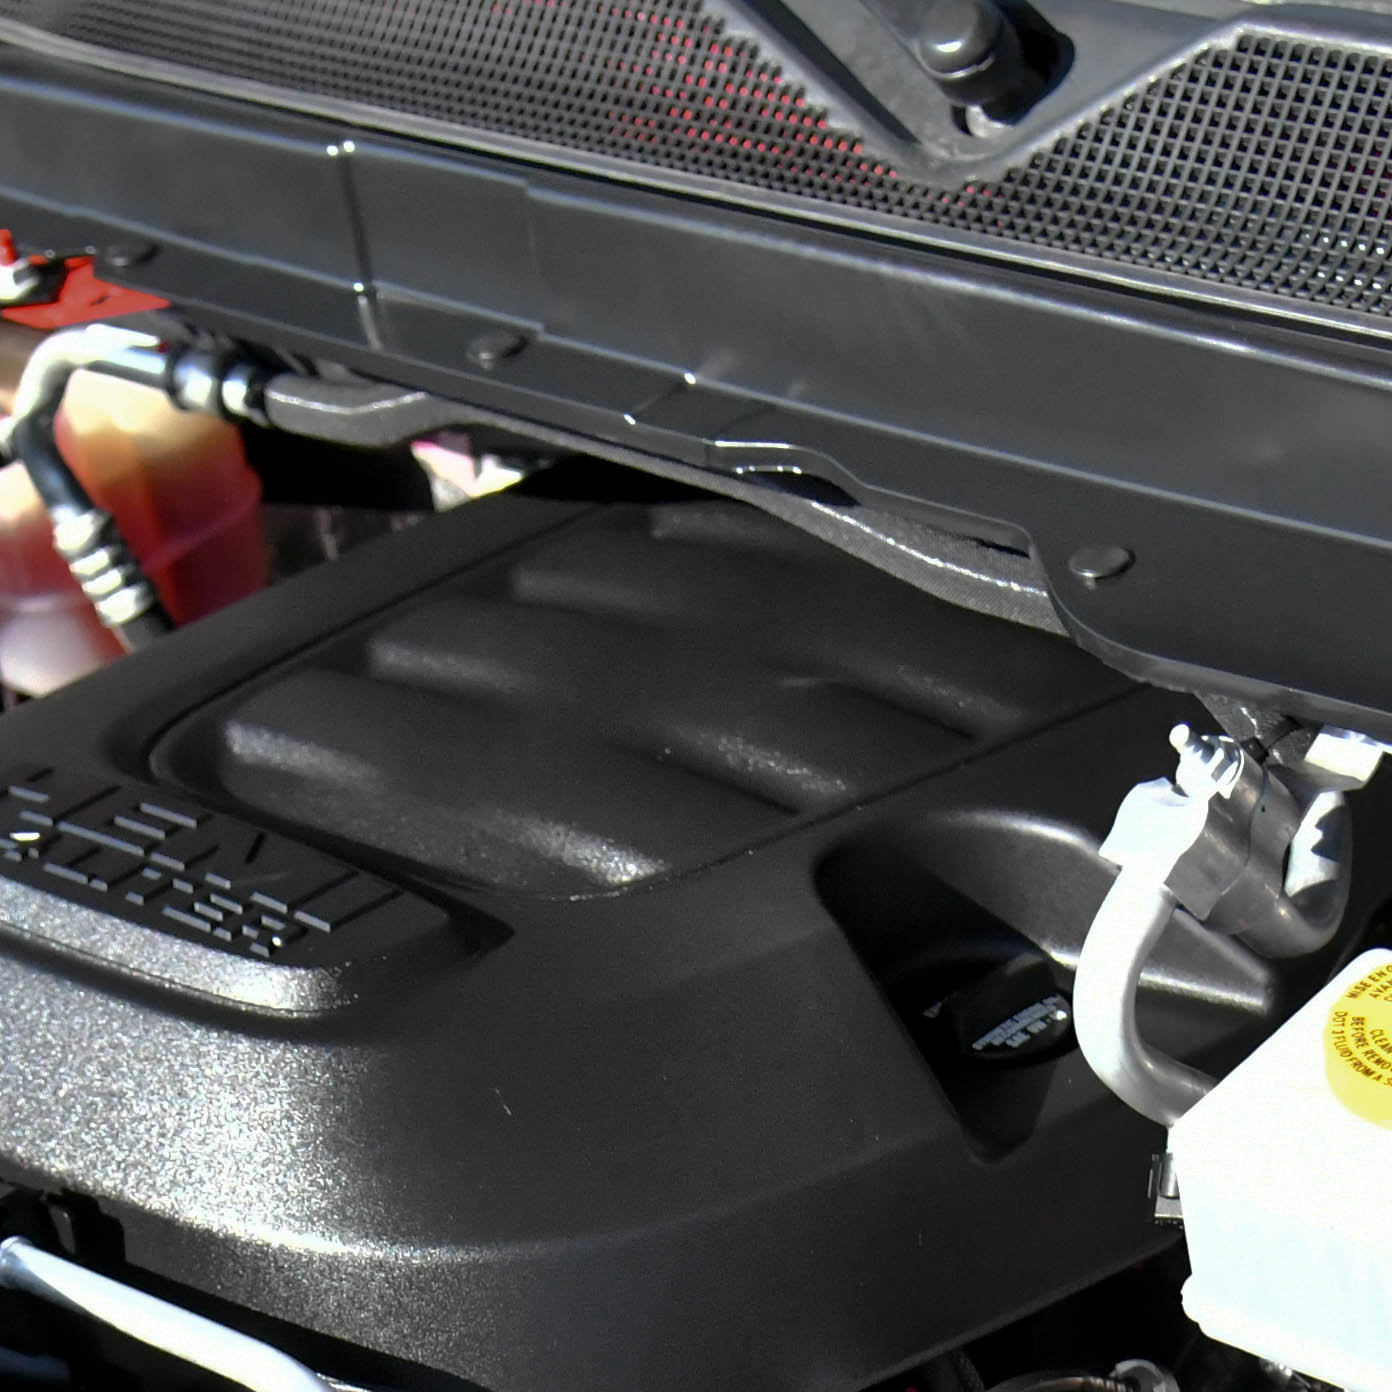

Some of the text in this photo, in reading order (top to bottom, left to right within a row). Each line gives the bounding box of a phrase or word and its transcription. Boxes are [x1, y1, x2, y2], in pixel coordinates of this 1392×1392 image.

[1345, 981, 1371, 998] MISE
[1368, 971, 1387, 983] EN
[1332, 1011, 1348, 1027] DOT
[1351, 1017, 1369, 1048] BEFORE
[1333, 1036, 1353, 1058] FLUID
[1345, 1057, 1376, 1077] FROM
